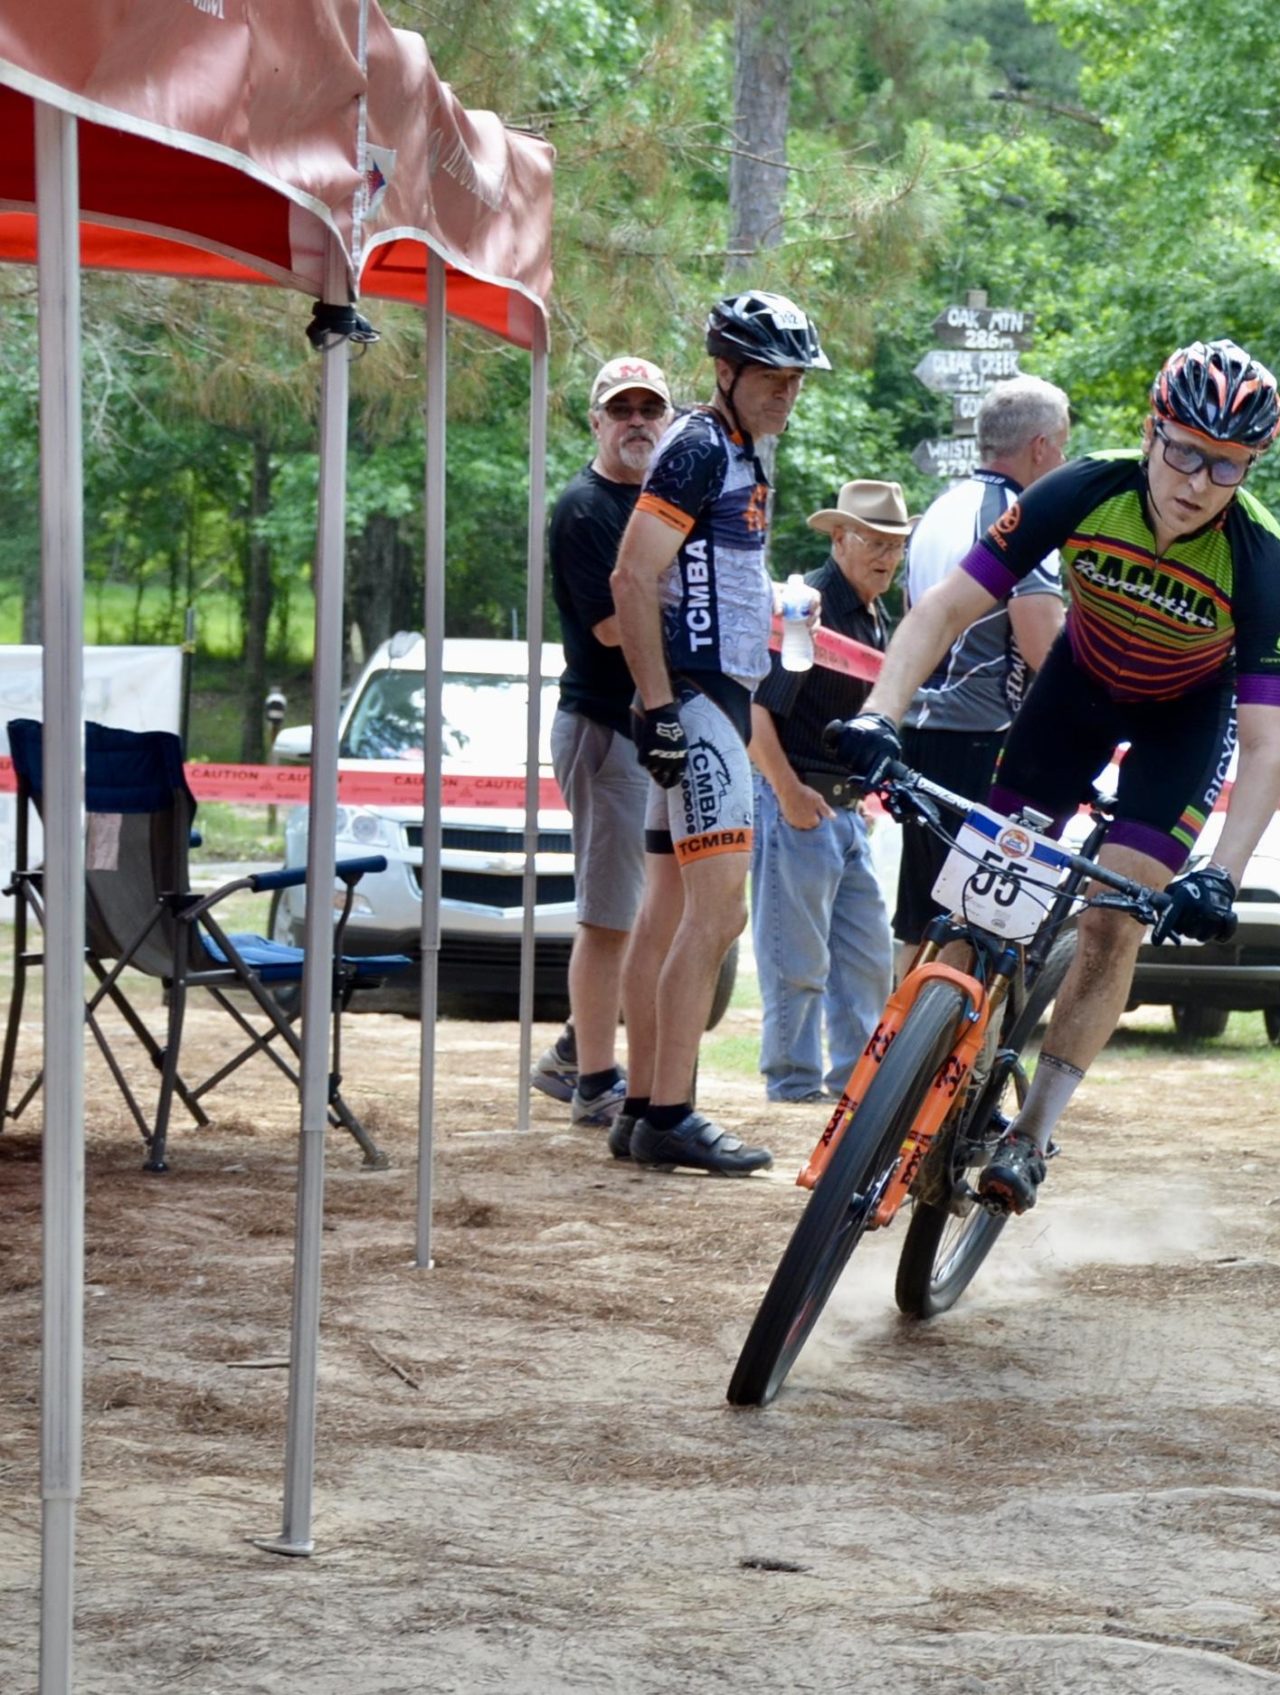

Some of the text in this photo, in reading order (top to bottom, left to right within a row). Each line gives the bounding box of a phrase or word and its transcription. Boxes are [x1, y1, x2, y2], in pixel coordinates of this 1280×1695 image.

[947, 308, 1024, 332] OAK MTN
[619, 365, 648, 380] M
[980, 351, 1019, 376] CREEK
[926, 440, 980, 459] WHISTL
[686, 539, 713, 652] TCMBA
[191, 769, 259, 780] CAUTION
[475, 779, 527, 790] CAUTIO
[689, 737, 718, 831] TCMBA
[678, 832, 746, 855] TCMBA
[971, 850, 1028, 907] 55
[864, 1023, 897, 1064] 32
[934, 1056, 968, 1097] 32
